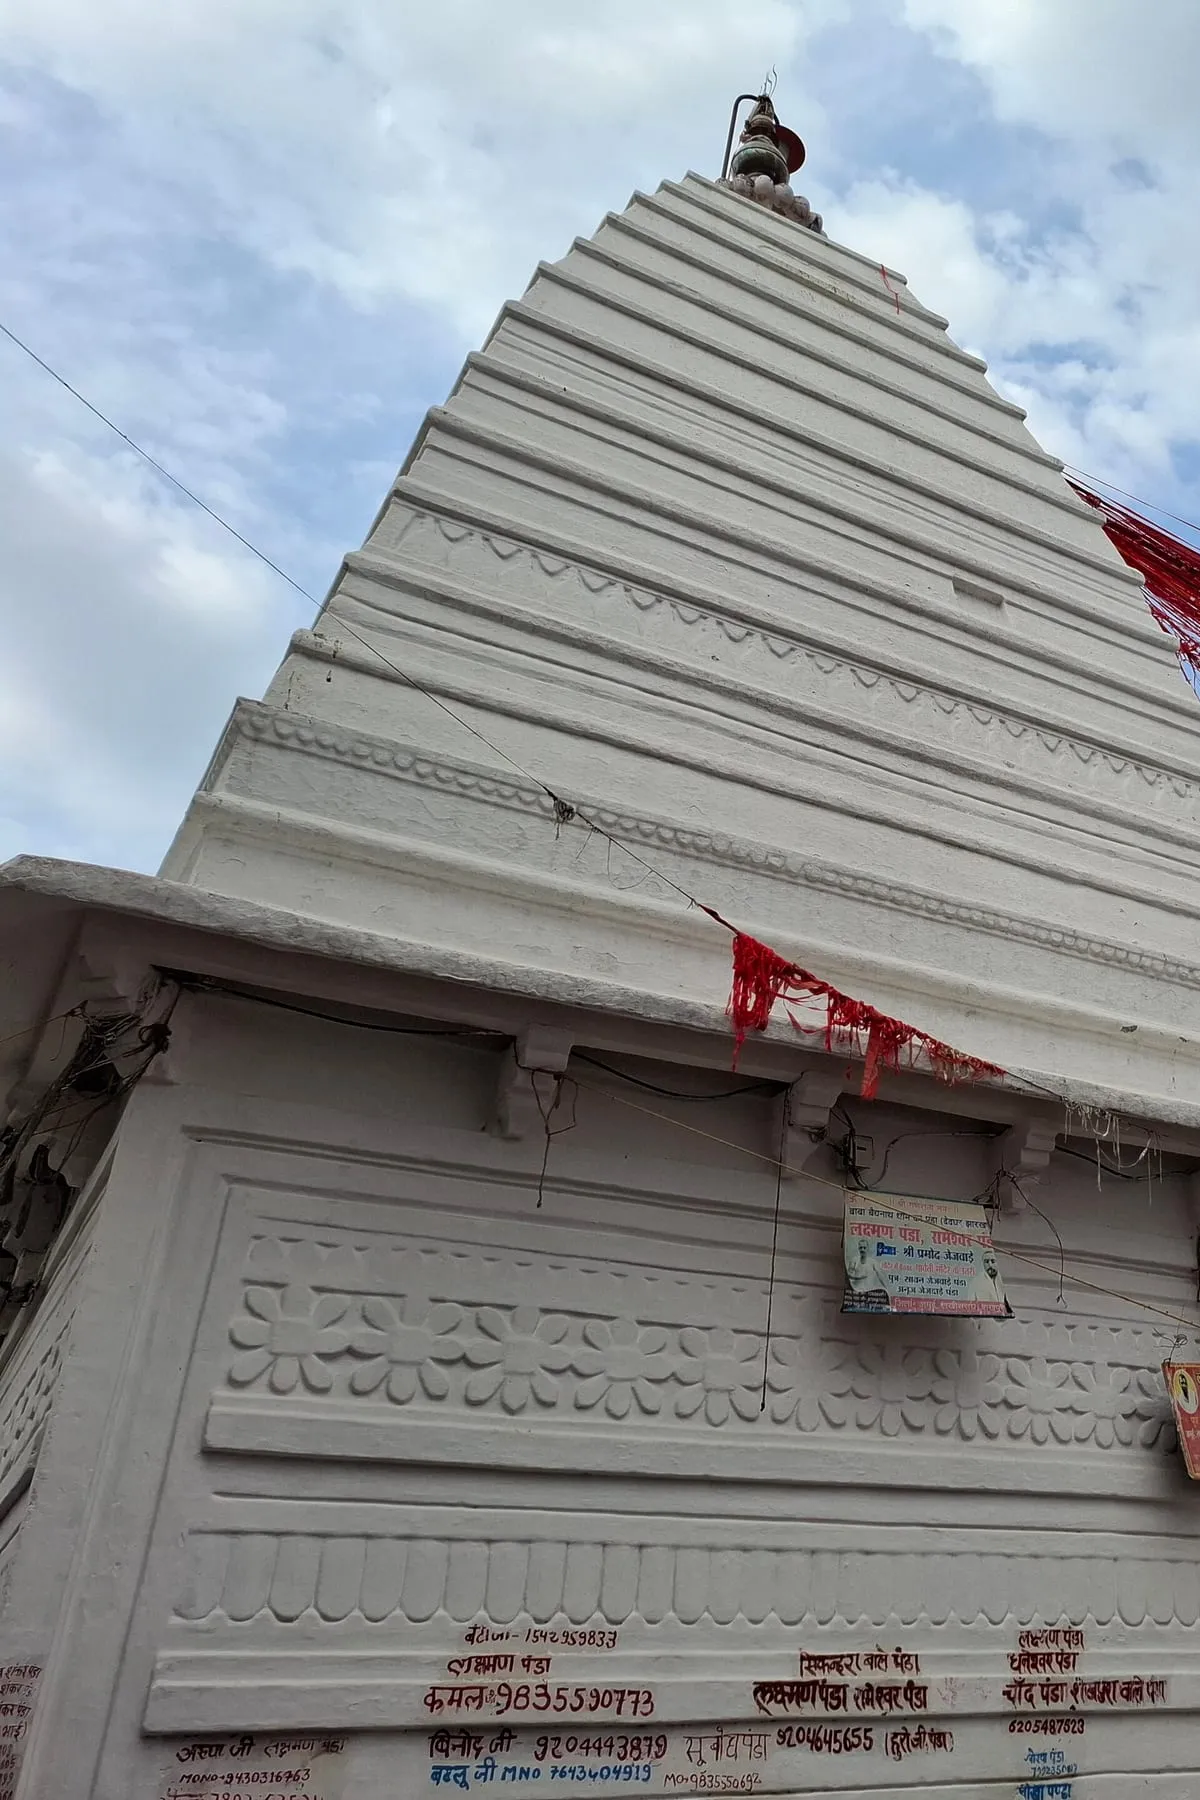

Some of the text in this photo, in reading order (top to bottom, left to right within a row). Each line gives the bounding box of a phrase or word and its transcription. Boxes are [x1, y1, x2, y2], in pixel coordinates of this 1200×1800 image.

[849, 1222, 894, 1240] लक्ष्मण
[903, 1246, 914, 1258] श्री
[916, 1246, 941, 1260] प्रमोद
[1062, 1626, 1085, 1649] पंडा
[447, 1654, 552, 1677] लक्ष्मण पंडा
[423, 1685, 487, 1713] कमल
[818, 1679, 850, 1712] पंडा
[853, 1682, 902, 1716] रामेश्वर
[903, 1680, 928, 1711] पंडा
[1002, 1677, 1036, 1709] चाँद
[1038, 1677, 1067, 1706] पंडा
[229, 1735, 254, 1758] जी
[474, 1756, 498, 1782] जी
